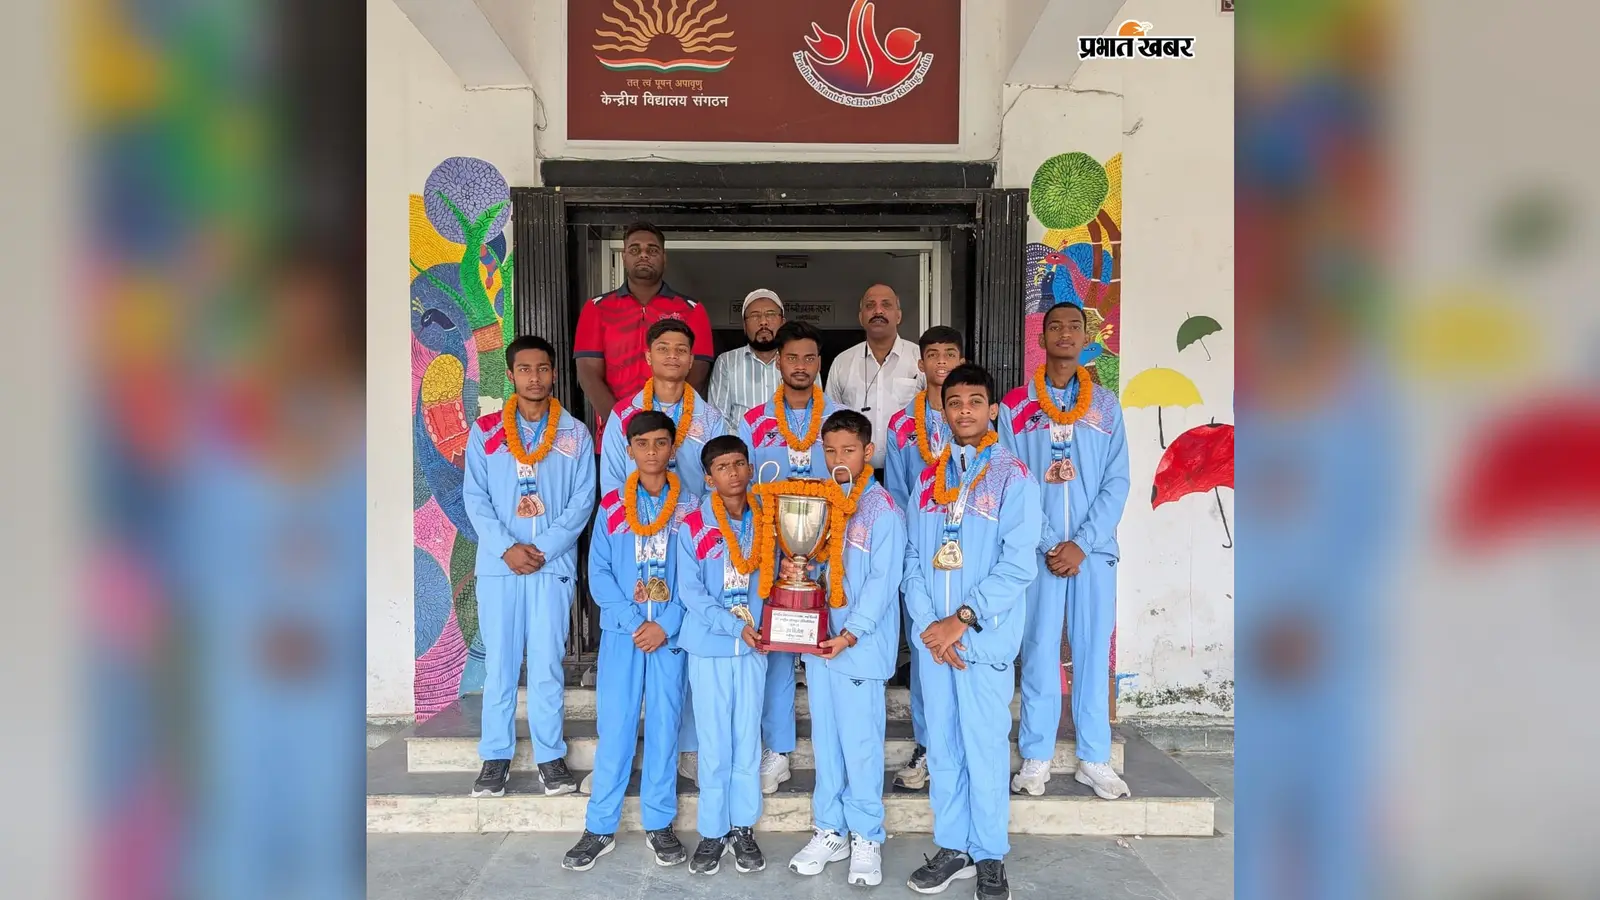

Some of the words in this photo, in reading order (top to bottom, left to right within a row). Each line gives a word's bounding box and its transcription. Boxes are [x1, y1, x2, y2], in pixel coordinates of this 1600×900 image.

[626, 78, 640, 89] तत्
[642, 77, 652, 88] त्वं
[655, 78, 673, 90] पूषन्
[675, 78, 704, 91] अपावृणु
[793, 51, 819, 88] Pradhan
[816, 82, 845, 104] Mantri
[882, 91, 898, 104] for
[896, 74, 923, 97] Rising
[917, 54, 933, 77] India
[600, 90, 639, 107] केन्द्रीय
[642, 91, 687, 107] विद्यालय
[692, 92, 729, 107] संगठन
